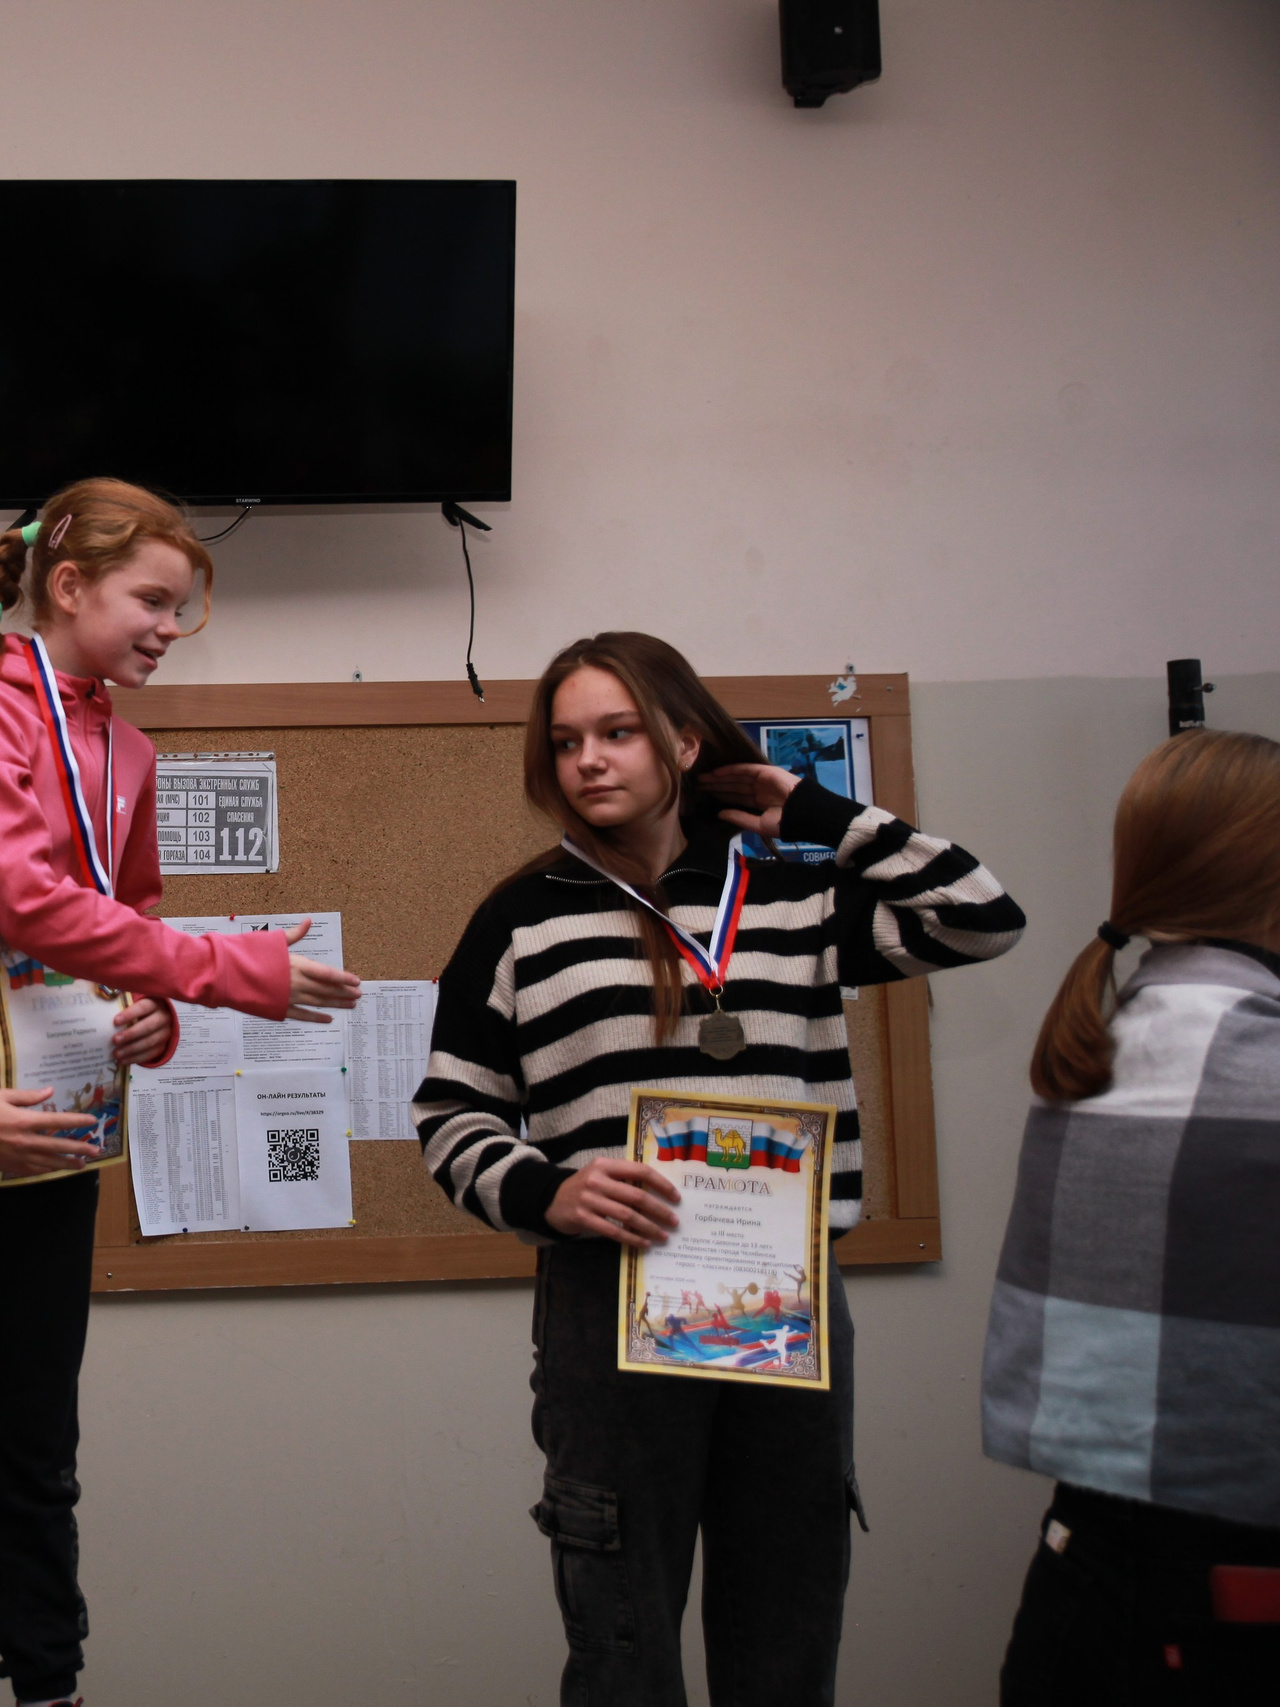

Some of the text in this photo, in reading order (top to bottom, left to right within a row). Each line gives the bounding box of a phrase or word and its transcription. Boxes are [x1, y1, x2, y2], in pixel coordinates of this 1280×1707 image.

[173, 778, 198, 790] ВЫЗОВА
[199, 779, 238, 791] ЭКСТРЕННЫХ
[240, 779, 260, 791] СЛУЖБ
[192, 794, 210, 806] 101
[218, 796, 263, 808] ЕДИНАЯ СЛУЖБА
[192, 812, 210, 823] 102
[226, 812, 254, 823] СПАСЕНИЯ
[158, 830, 182, 843] ПОМОЩЬ
[192, 830, 210, 842] 103
[219, 827, 263, 861] 112
[163, 849, 186, 861] ГОРГАЗА
[193, 849, 211, 861] 104
[256, 1092, 286, 1100] ОН-ЛАЙН
[682, 1174, 771, 1195] ГРАМОТА
[704, 1203, 753, 1212] награждается
[694, 1213, 761, 1227] Горбачева Ирина
[690, 1237, 711, 1245] группе
[726, 1231, 745, 1239] место
[663, 1251, 703, 1261] спортивному
[703, 1255, 756, 1265] ориентированию
[719, 1248, 740, 1256] города
[741, 1250, 776, 1259] Челябинска
